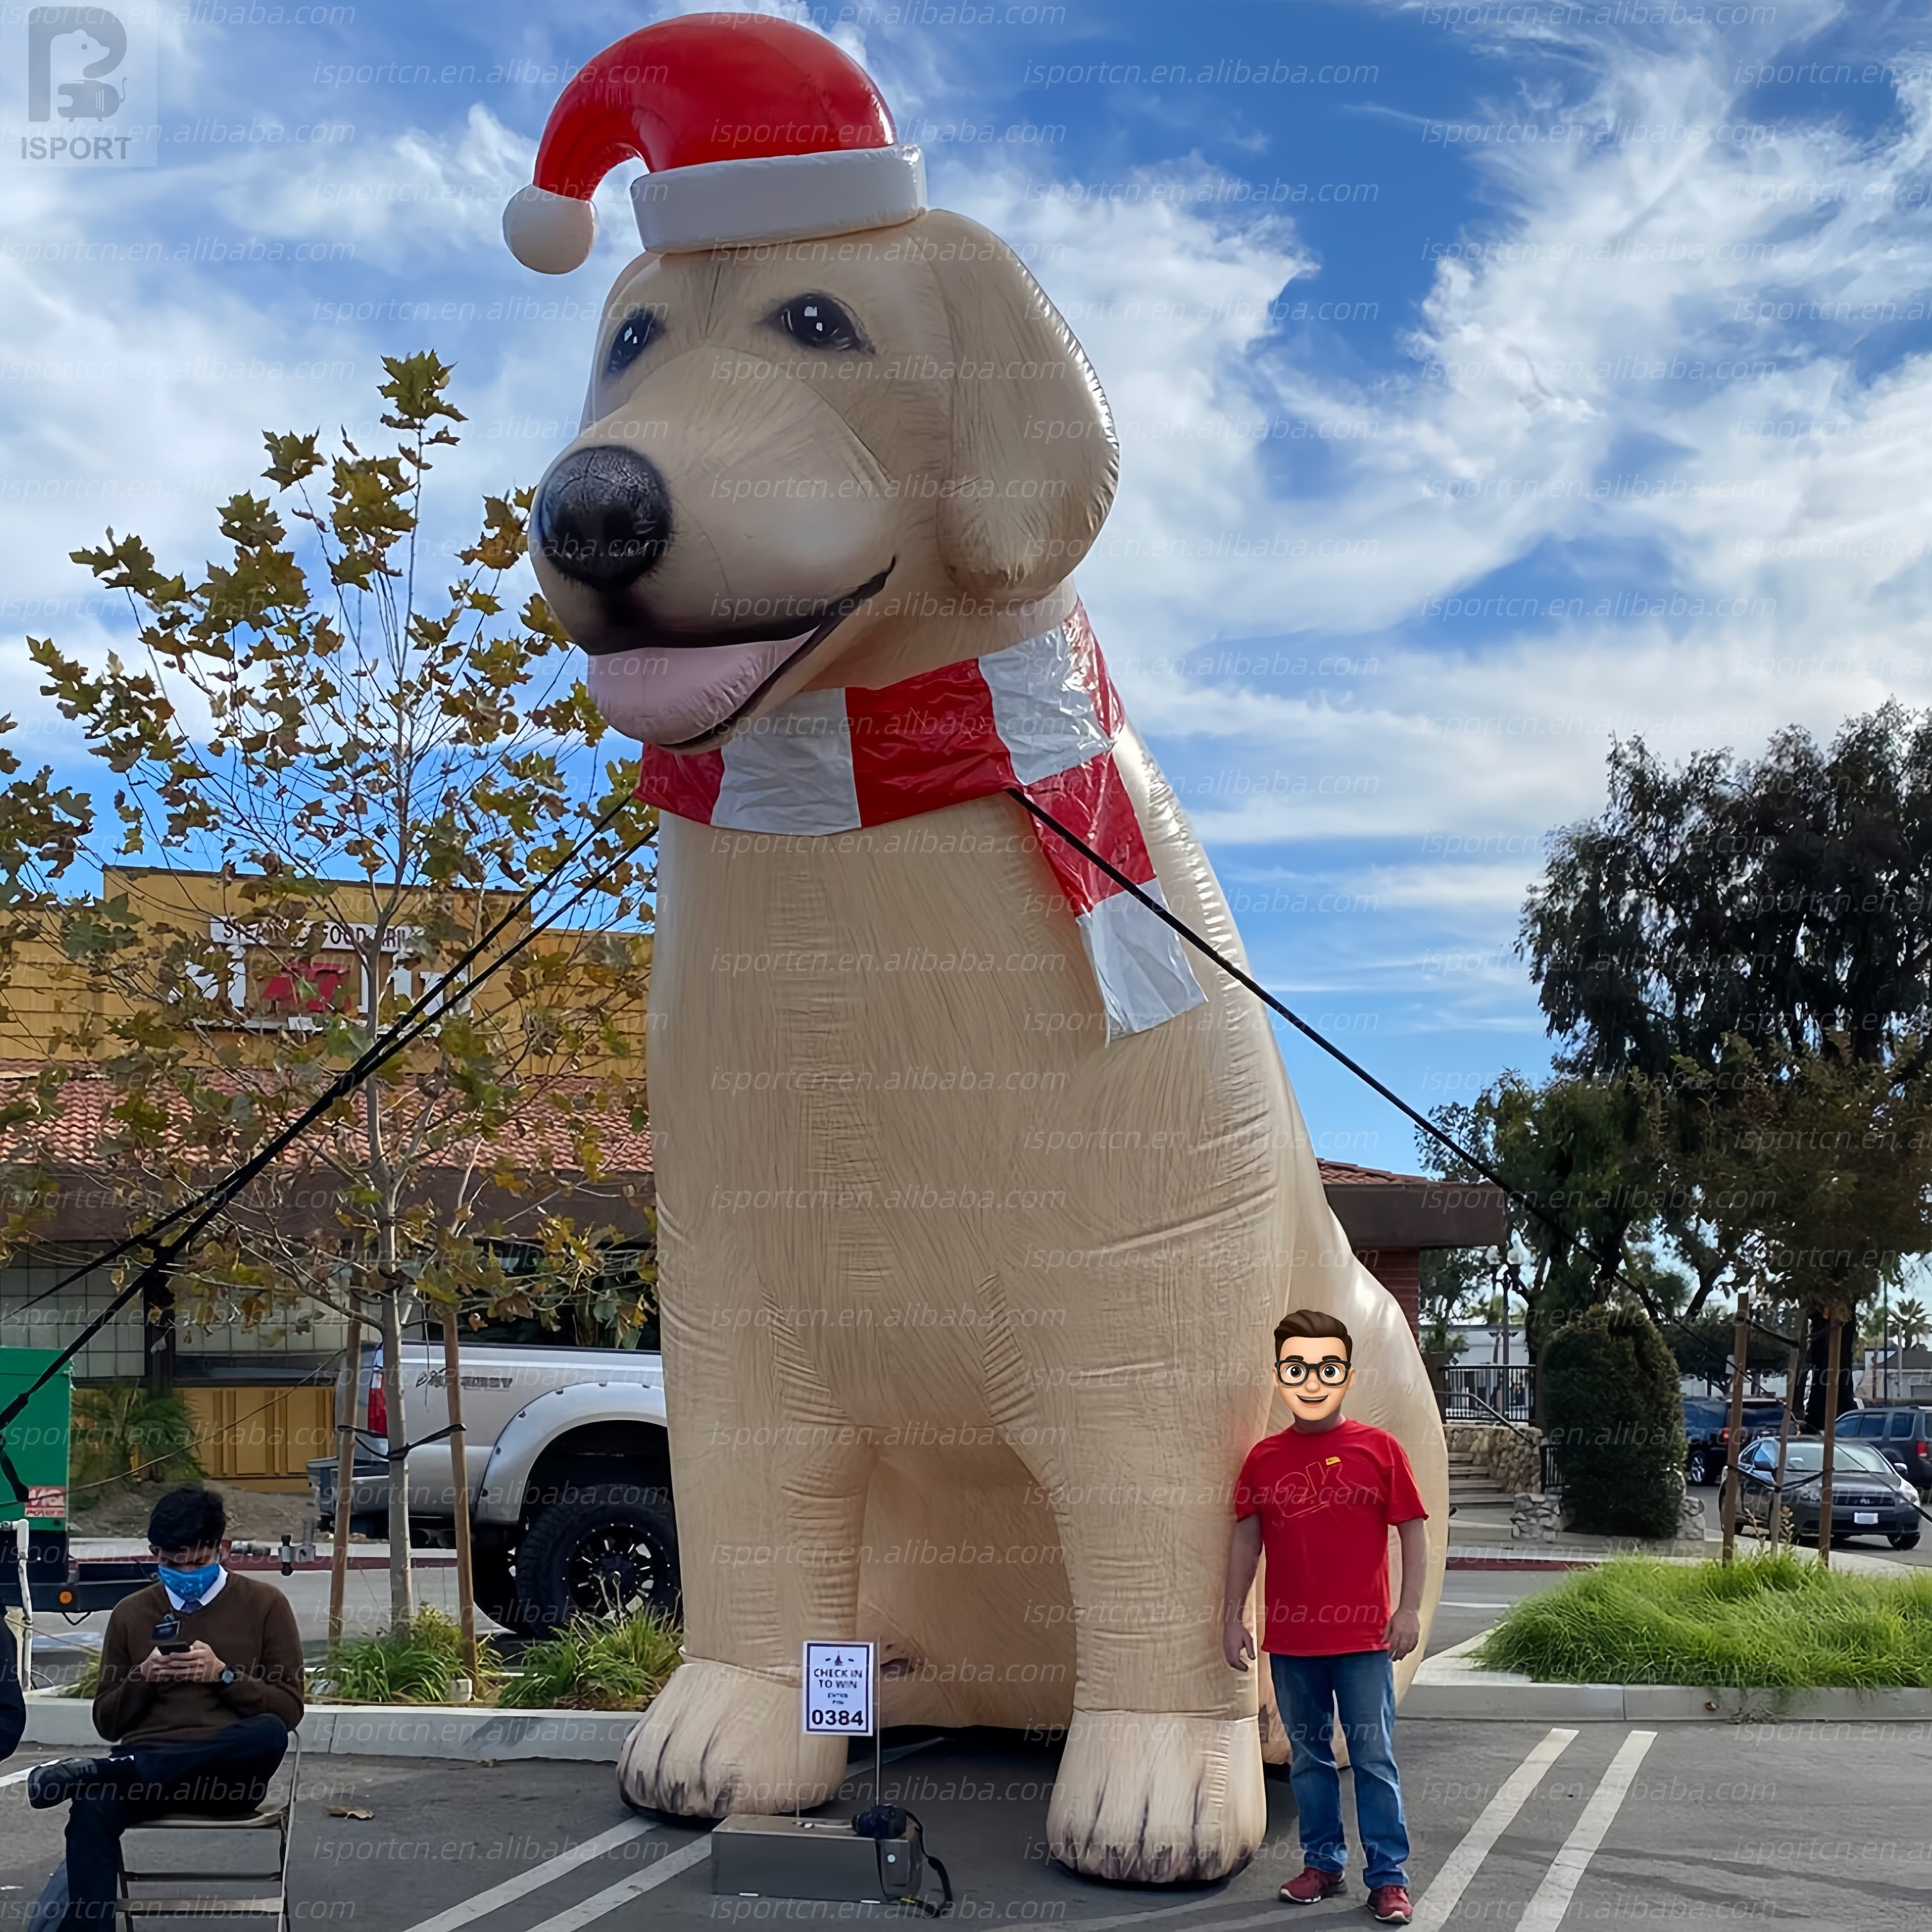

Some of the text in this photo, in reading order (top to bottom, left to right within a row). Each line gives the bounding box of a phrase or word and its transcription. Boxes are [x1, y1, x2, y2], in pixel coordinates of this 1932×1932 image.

[819, 1679, 857, 1688] TO WIN
[812, 1709, 864, 1726] 0384
